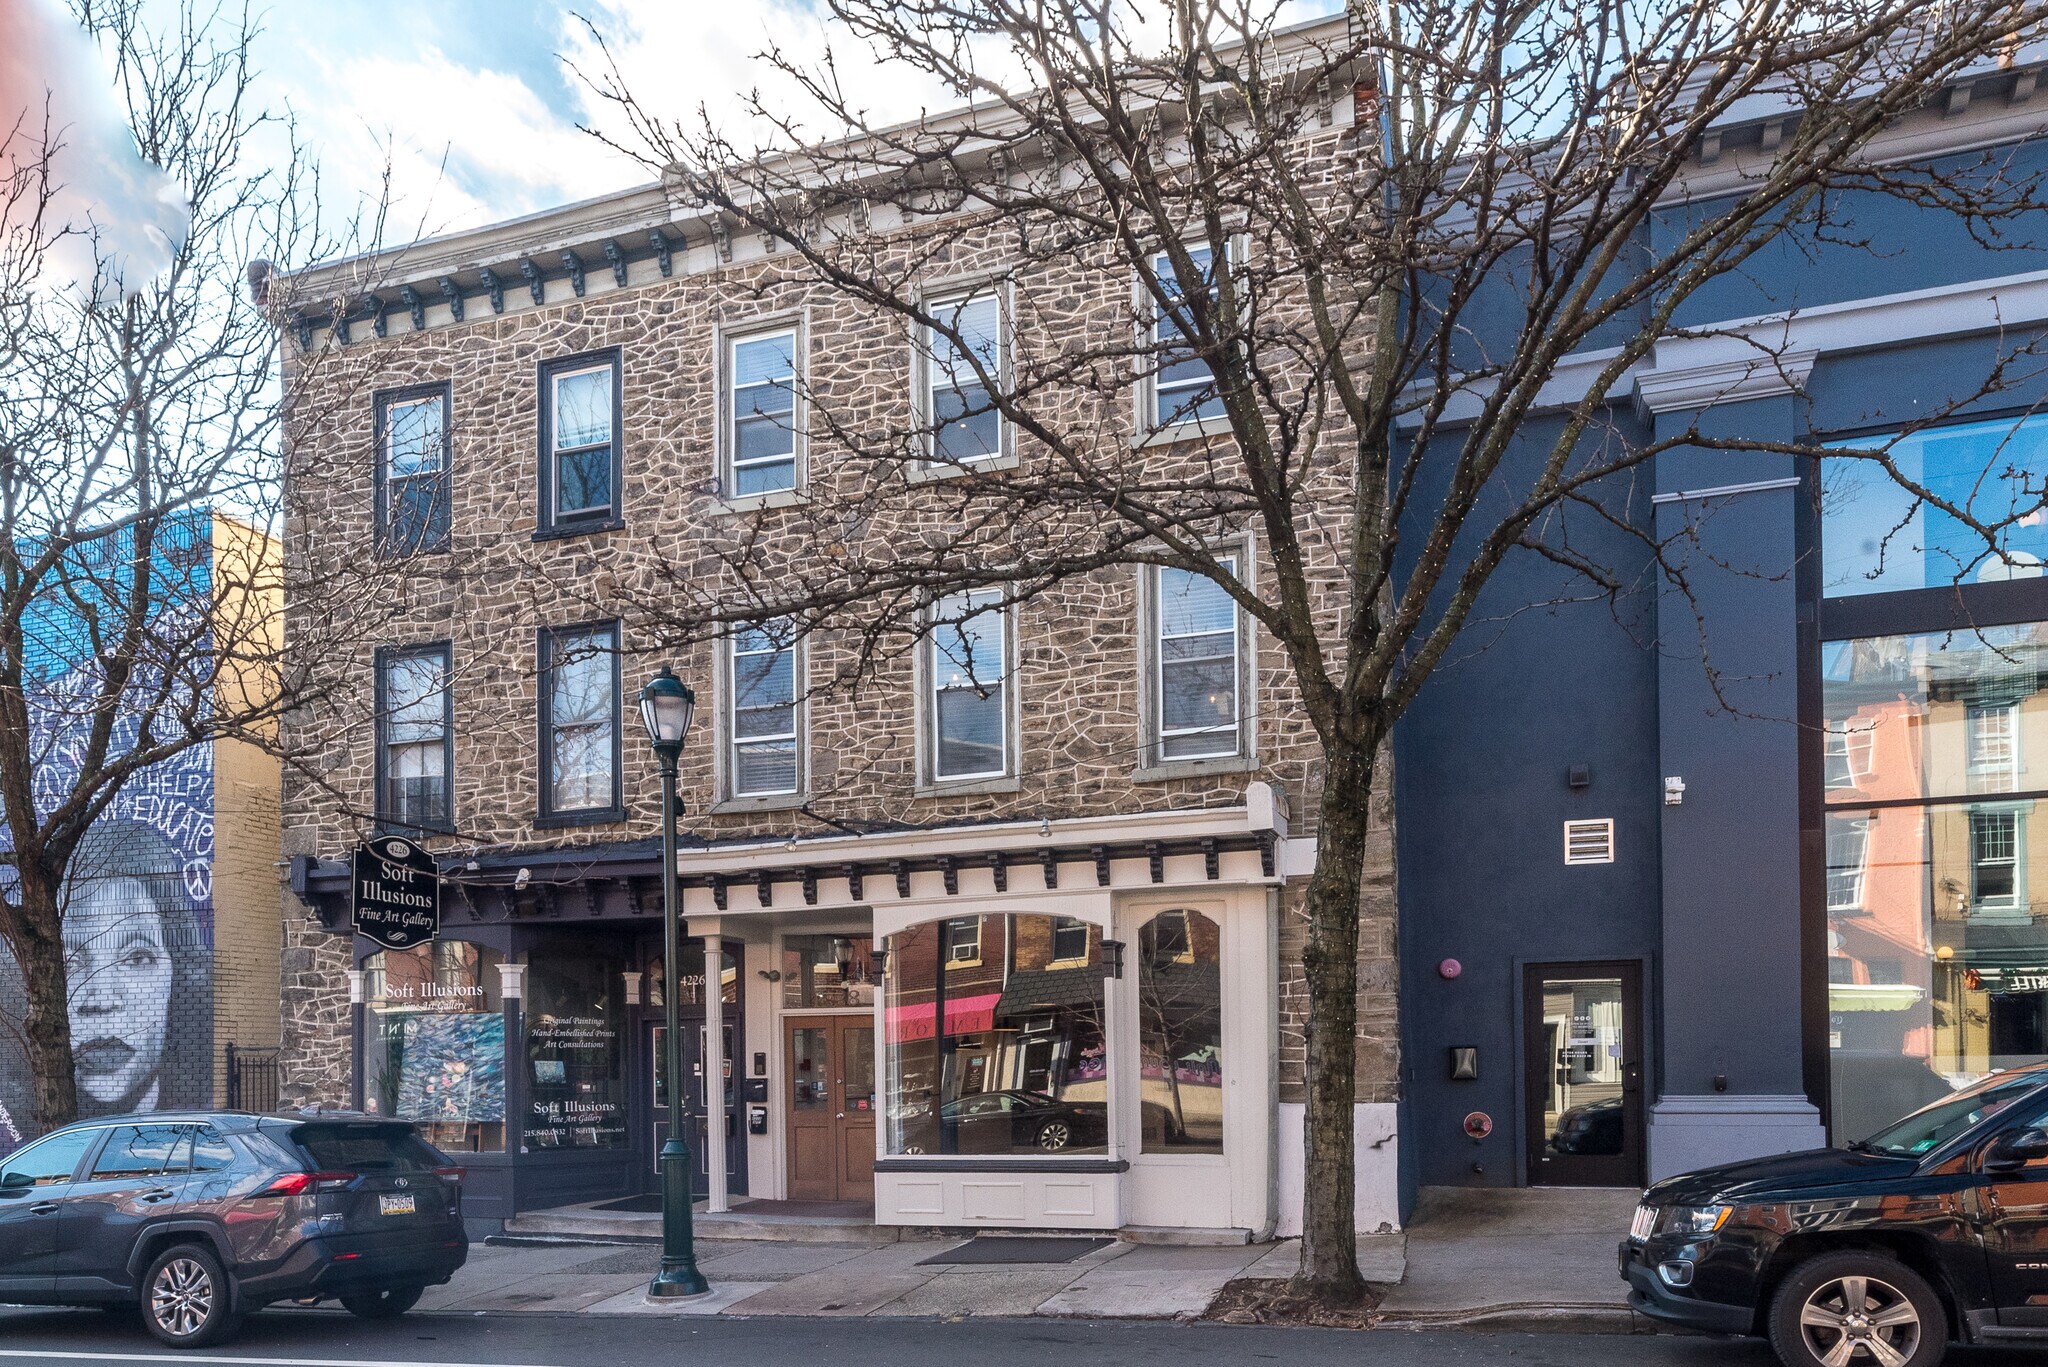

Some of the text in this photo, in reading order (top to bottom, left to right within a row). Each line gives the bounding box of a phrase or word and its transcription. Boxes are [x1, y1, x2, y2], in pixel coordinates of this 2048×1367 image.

[147, 774, 211, 800] HELP!
[389, 844, 408, 855] 4226
[381, 861, 415, 883] Soft
[361, 880, 432, 908] Illusions
[359, 907, 434, 930] Fine Art Gallery
[680, 975, 706, 986] 4226
[385, 981, 483, 998] Soft Illusions
[401, 1000, 467, 1013] Fine Art Gallery
[543, 1016, 605, 1027] Original Paintings
[531, 1028, 616, 1038] Hand-Embellished Prints
[543, 1039, 604, 1049] Art Consultations
[533, 1100, 615, 1114] Soft Illusions
[548, 1114, 602, 1124] Fine Art Gallery
